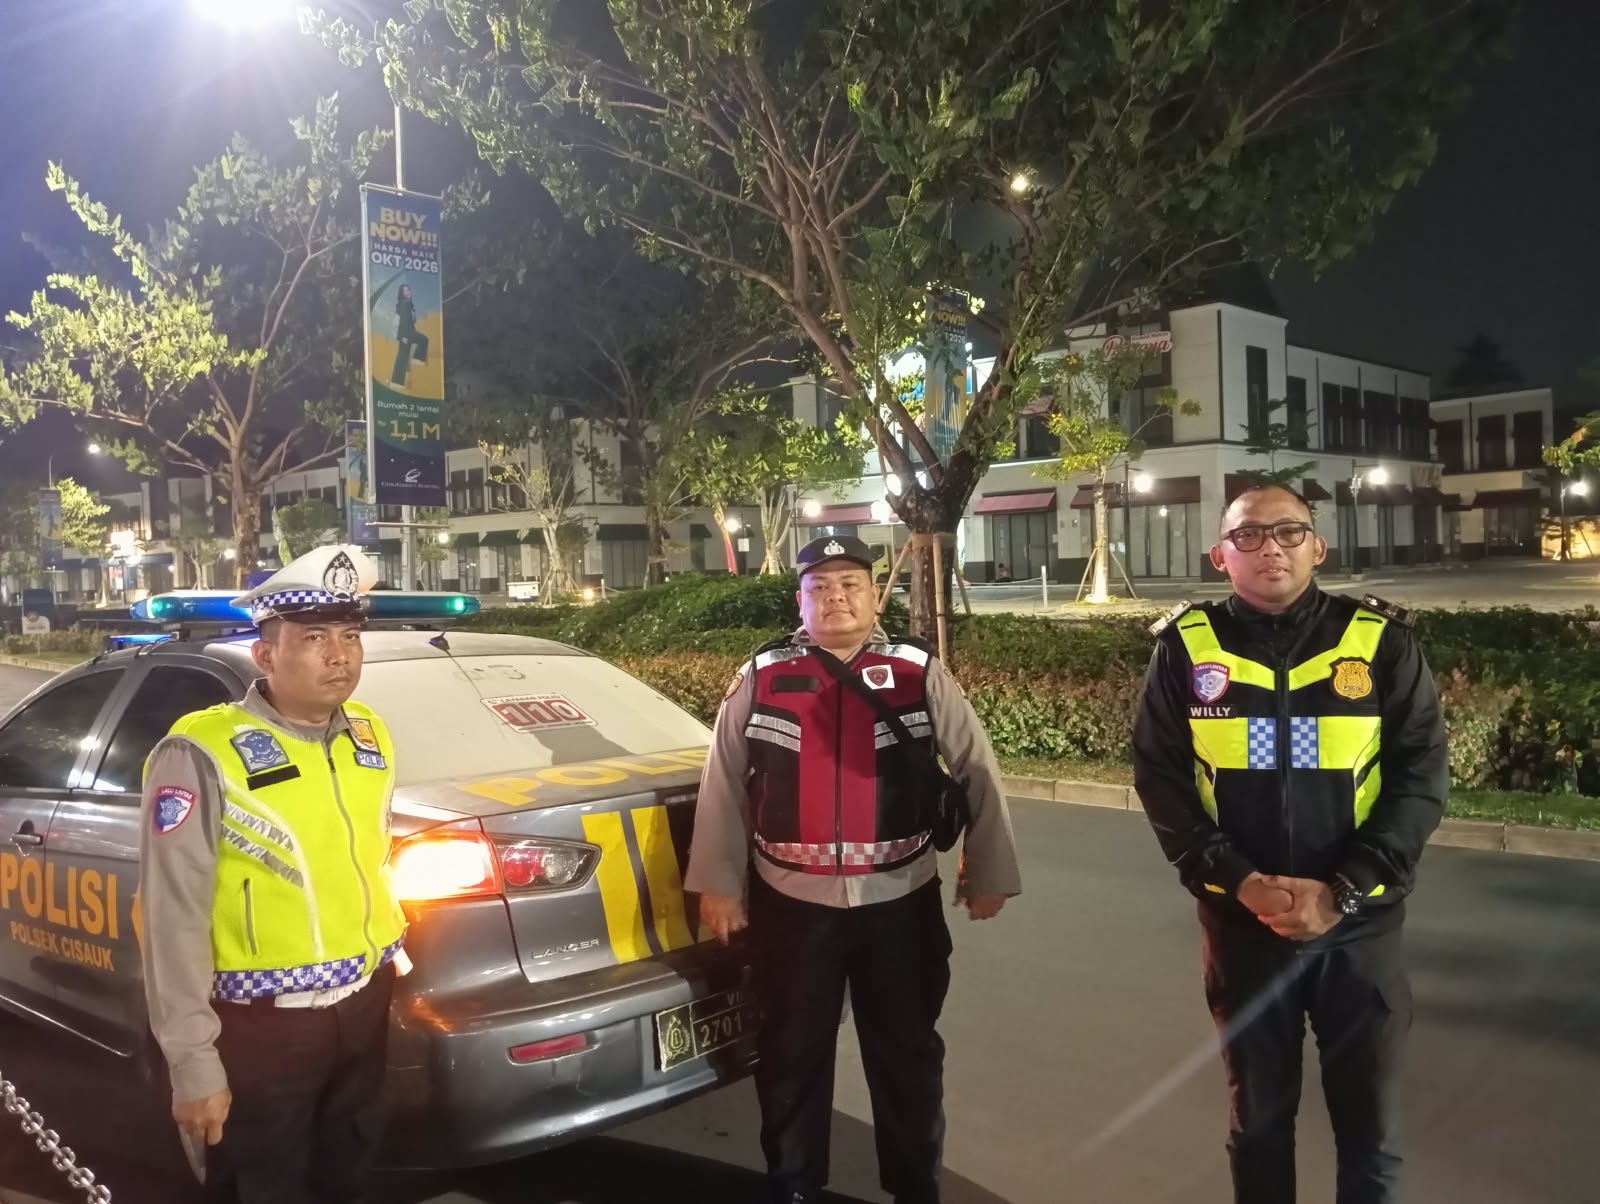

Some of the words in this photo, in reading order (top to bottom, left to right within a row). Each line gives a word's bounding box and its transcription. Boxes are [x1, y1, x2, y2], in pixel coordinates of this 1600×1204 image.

[380, 207, 427, 229] BUY
[370, 221, 437, 247] NOW!!!
[374, 242, 407, 255] HARGA
[411, 250, 434, 260] NAIK
[371, 251, 402, 267] OKT
[405, 257, 438, 273] 2026
[377, 400, 408, 410] Rumah
[416, 405, 440, 413] lantai
[390, 420, 418, 441] 1,1
[422, 422, 440, 440] M
[501, 702, 580, 723] 110
[1190, 707, 1231, 717] WILLY
[0, 852, 118, 940] POLISI
[10, 921, 58, 954] POLSEK
[61, 936, 115, 972] CISAUK
[531, 939, 599, 959] LANCER
[700, 1012, 742, 1048] 2701
